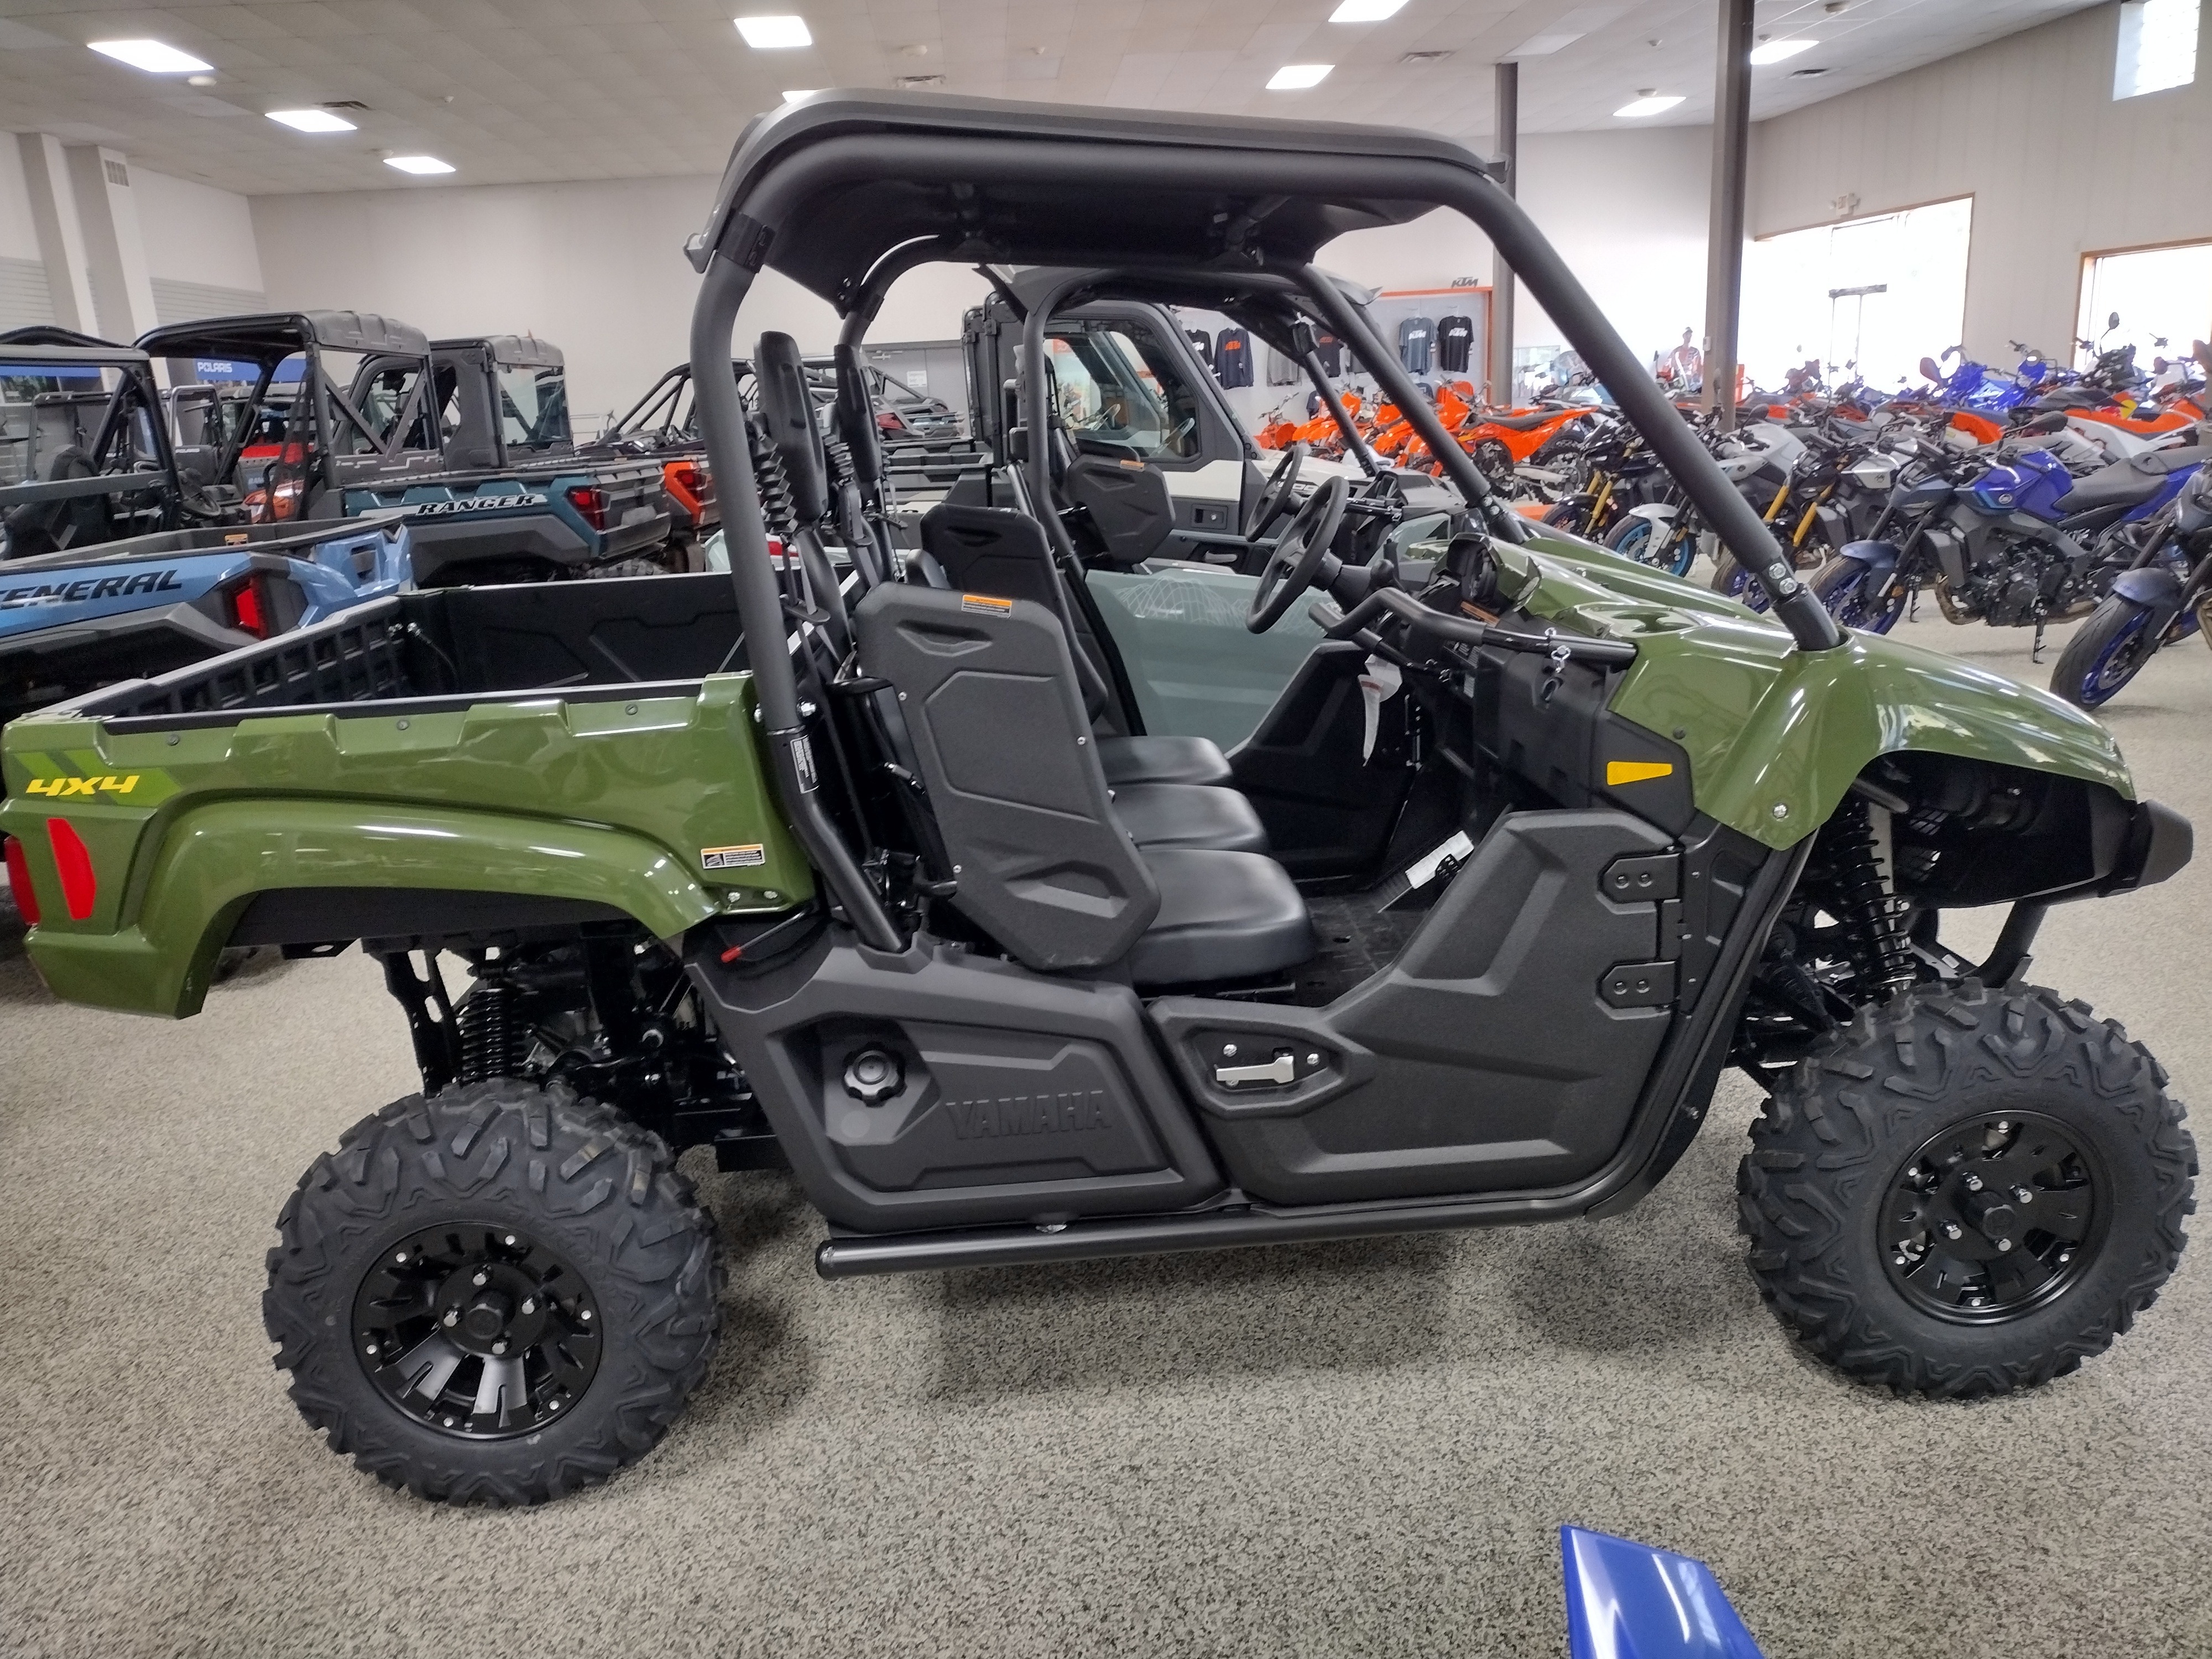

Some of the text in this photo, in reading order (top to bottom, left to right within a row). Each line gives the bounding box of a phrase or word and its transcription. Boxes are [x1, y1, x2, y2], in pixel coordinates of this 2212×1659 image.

[1451, 276, 1479, 288] KTM
[1408, 330, 1427, 340] KTM
[1449, 327, 1468, 337] KTM
[197, 362, 232, 373] POLARIS
[416, 494, 536, 515] RANGER
[945, 1090, 1113, 1140] YAMAHA
